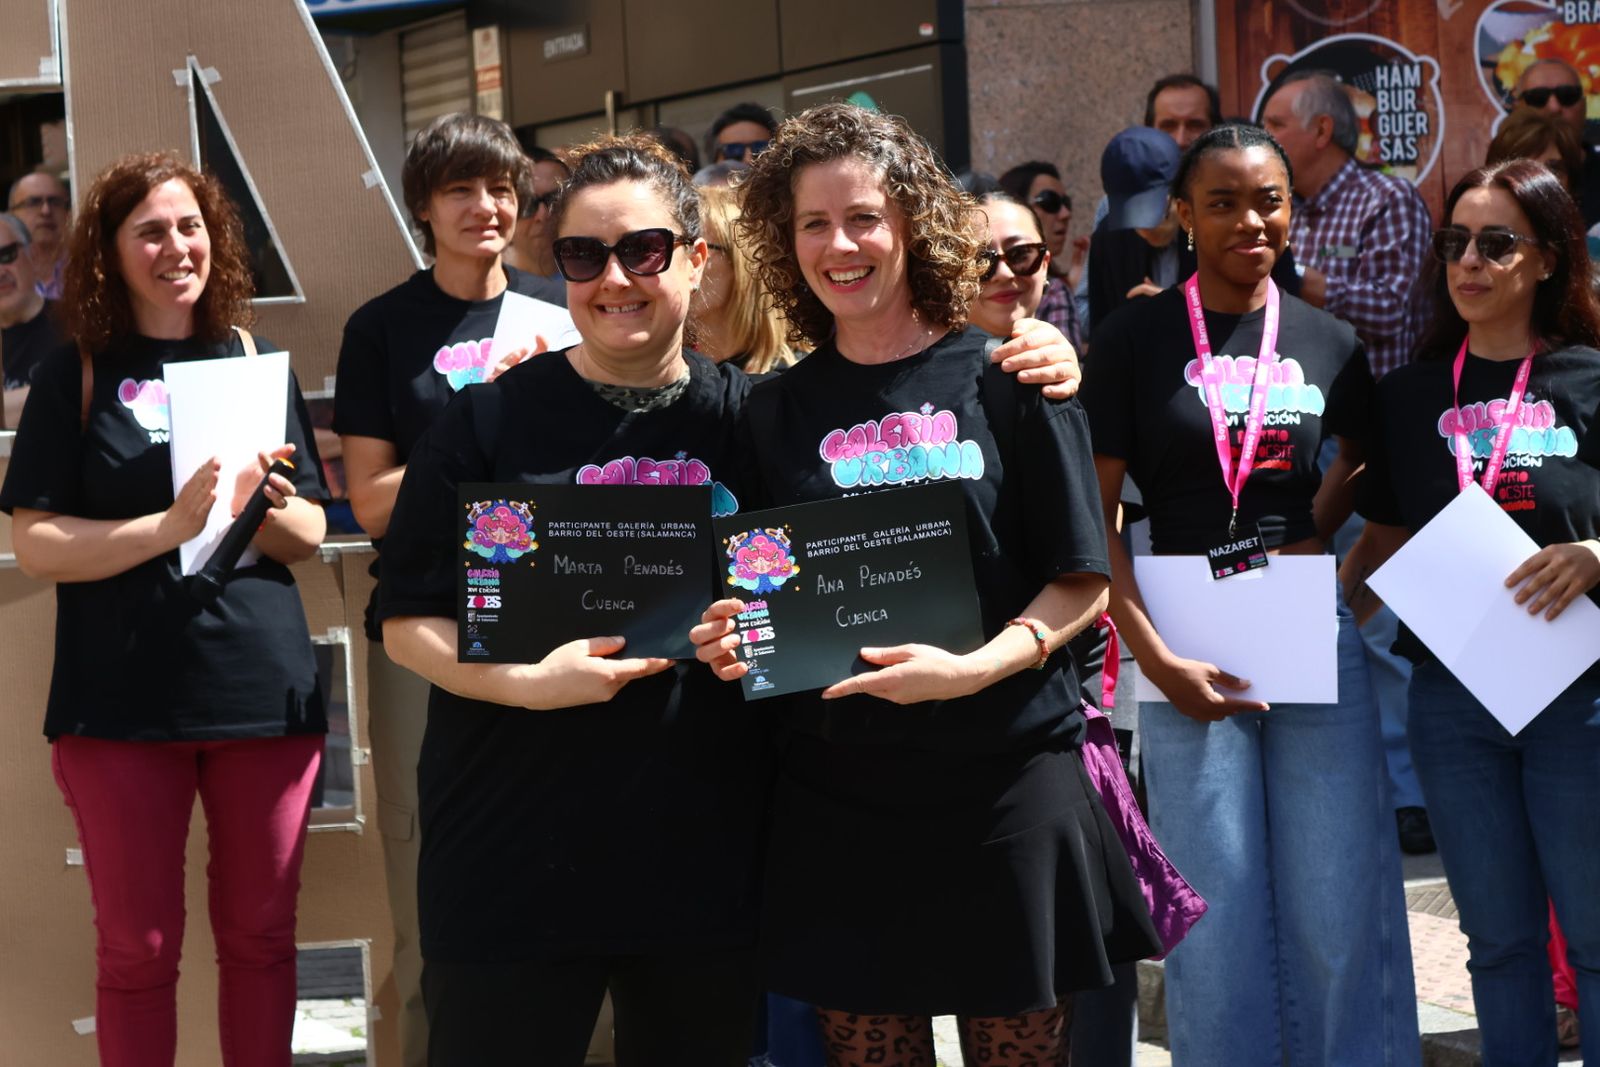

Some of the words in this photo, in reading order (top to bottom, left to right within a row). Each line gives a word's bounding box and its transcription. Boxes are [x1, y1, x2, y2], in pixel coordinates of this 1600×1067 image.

[543, 33, 585, 59] ENTRADA
[1376, 63, 1421, 89] HAM
[1377, 89, 1416, 113] BUR
[1378, 112, 1428, 136] GUER
[1380, 136, 1418, 160] SAS
[831, 440, 985, 489] URBANA
[548, 522, 611, 530] PARTICIPANTE
[617, 521, 655, 530] GALERÍA
[660, 522, 696, 530] URBANA
[548, 530, 582, 538] BARRIO
[586, 530, 603, 538] DEL
[606, 530, 635, 538] OESTE
[637, 530, 696, 539] (SALAMANCA)
[806, 533, 867, 550] PARTICIPANTE
[873, 525, 911, 540] GALERÍA
[915, 520, 951, 532] URBANA
[807, 545, 840, 558] BARRIO
[843, 542, 860, 552] DEL
[863, 537, 892, 549] OESTE
[894, 527, 952, 545] (SALAMANCA)
[1209, 536, 1258, 558] NAZARET
